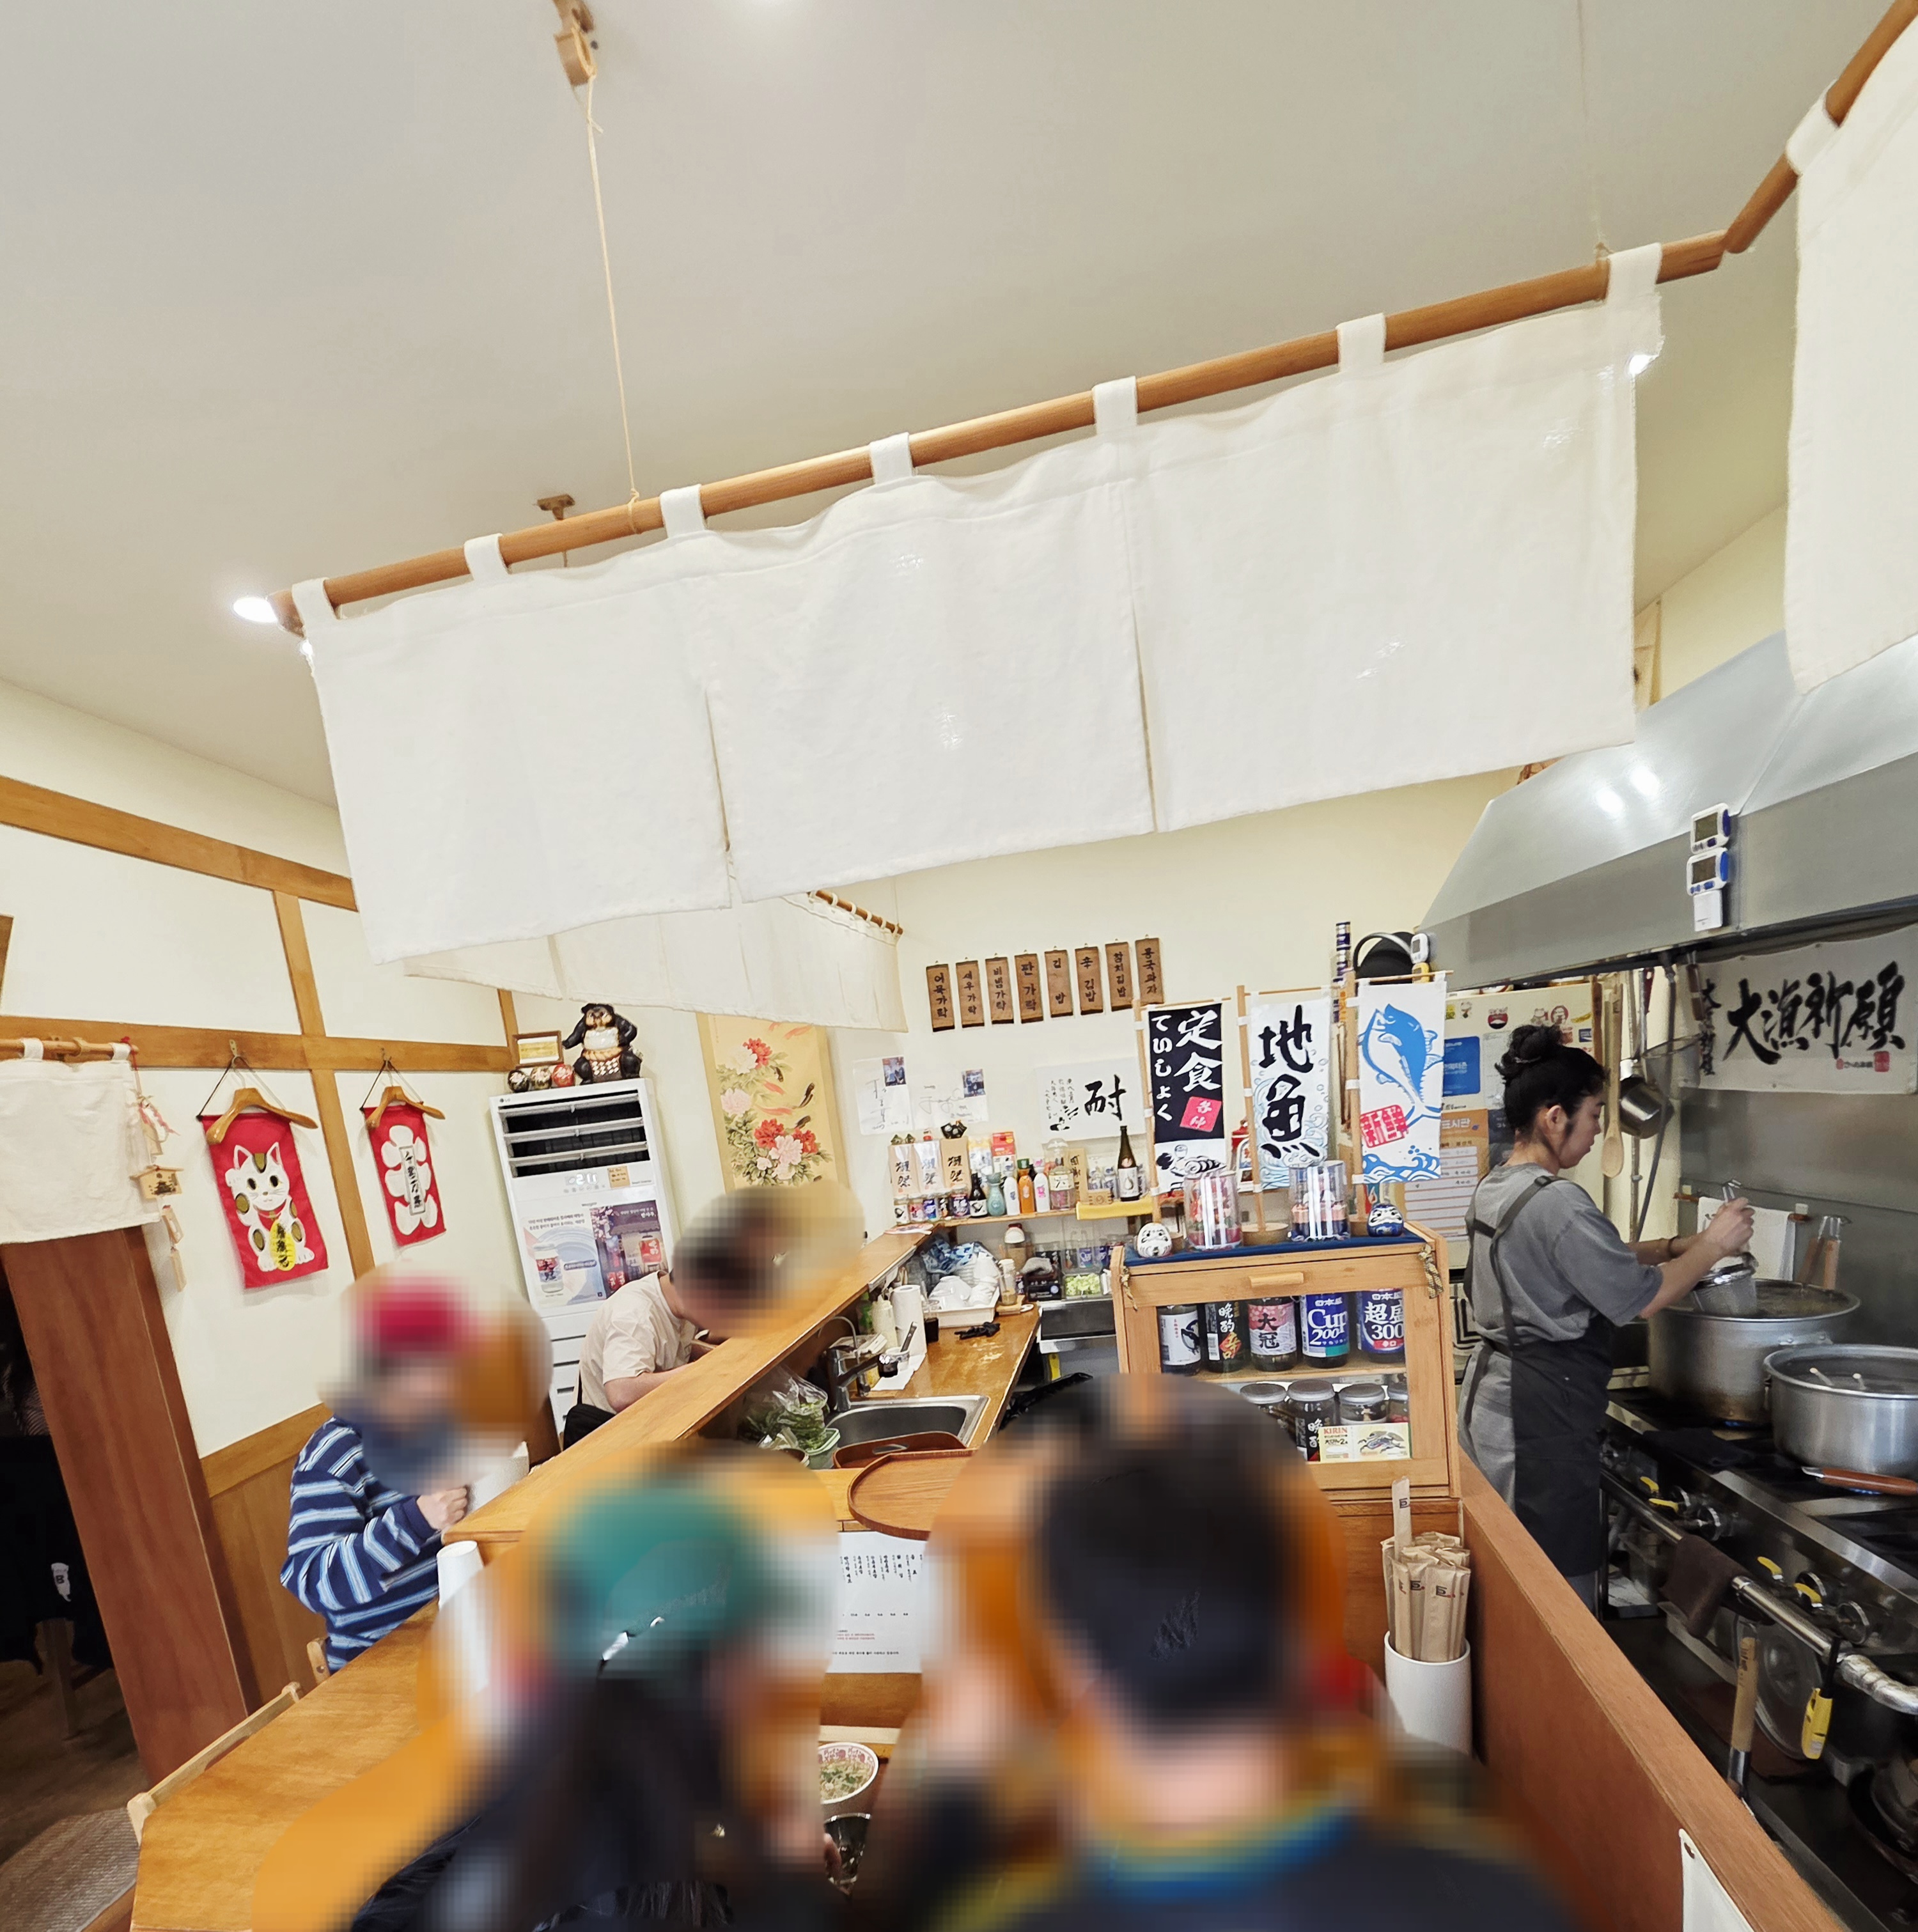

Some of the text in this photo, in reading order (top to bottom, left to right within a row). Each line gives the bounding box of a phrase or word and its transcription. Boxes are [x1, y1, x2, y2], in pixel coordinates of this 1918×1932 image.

[933, 972, 948, 1018] 어묵가락
[993, 965, 1008, 1011] 비빔가락
[1084, 978, 1097, 1002] 김밥
[1114, 951, 1127, 998] 참치김밥
[1722, 960, 1906, 1065] 大漁祈願
[1174, 1009, 1223, 1093] 定食
[1258, 1004, 1321, 1160] 地魚
[1307, 1309, 1348, 1334] Cup
[1309, 1328, 1339, 1346] 200
[1371, 1324, 1404, 1340] 300
